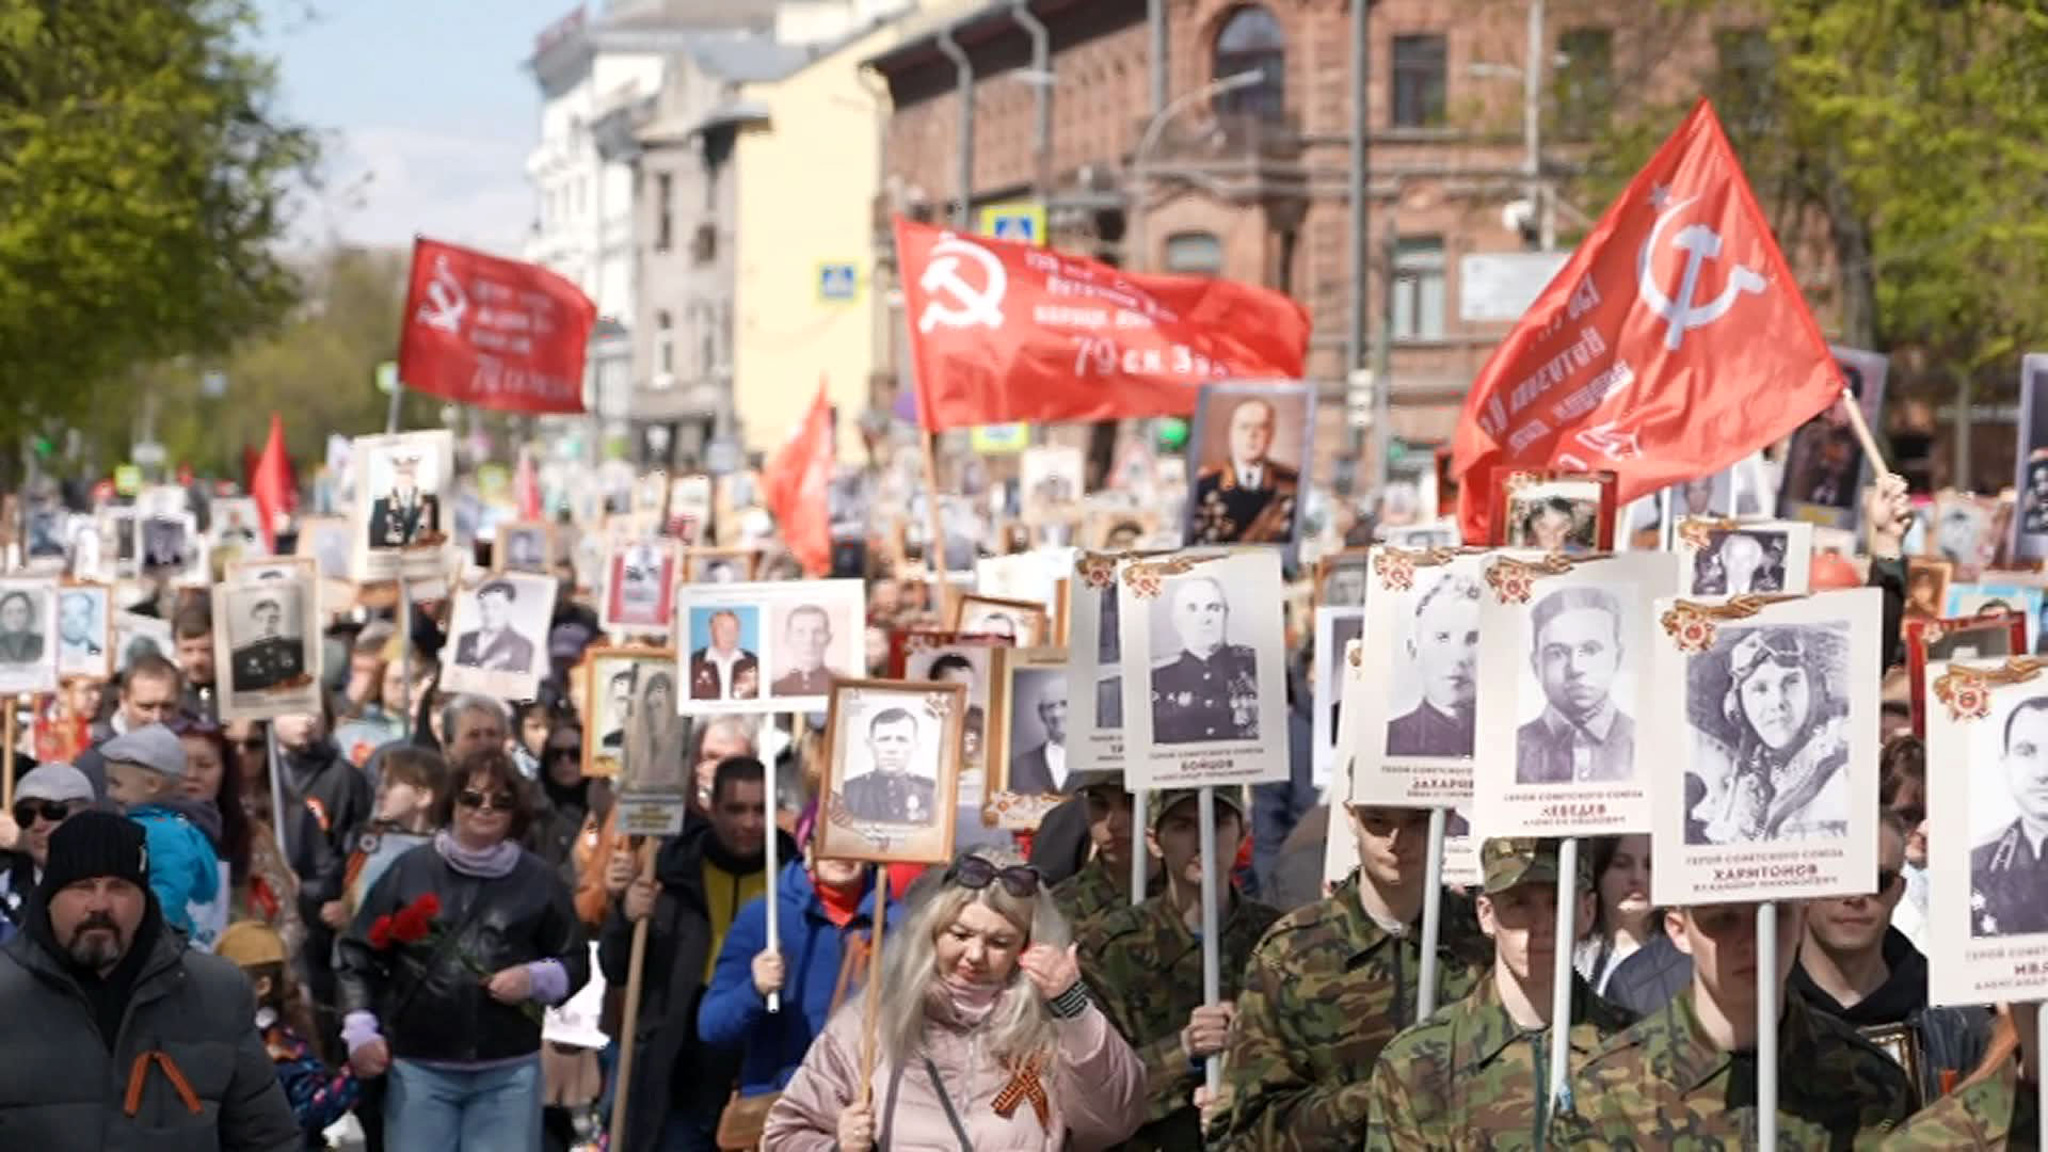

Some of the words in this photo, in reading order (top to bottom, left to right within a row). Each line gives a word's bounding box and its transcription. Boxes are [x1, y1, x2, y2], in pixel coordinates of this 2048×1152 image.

[1180, 758, 1235, 772] БОЙЦОВ
[1540, 803, 1606, 818] ЛЕБЕДЕВ
[1685, 855, 1722, 866] ГЕРОЙ
[1724, 852, 1800, 864] СОВЕТСКОГО
[1712, 863, 1819, 880] ХАРИТОНОВ
[1965, 948, 2005, 960] ГЕРОЙ
